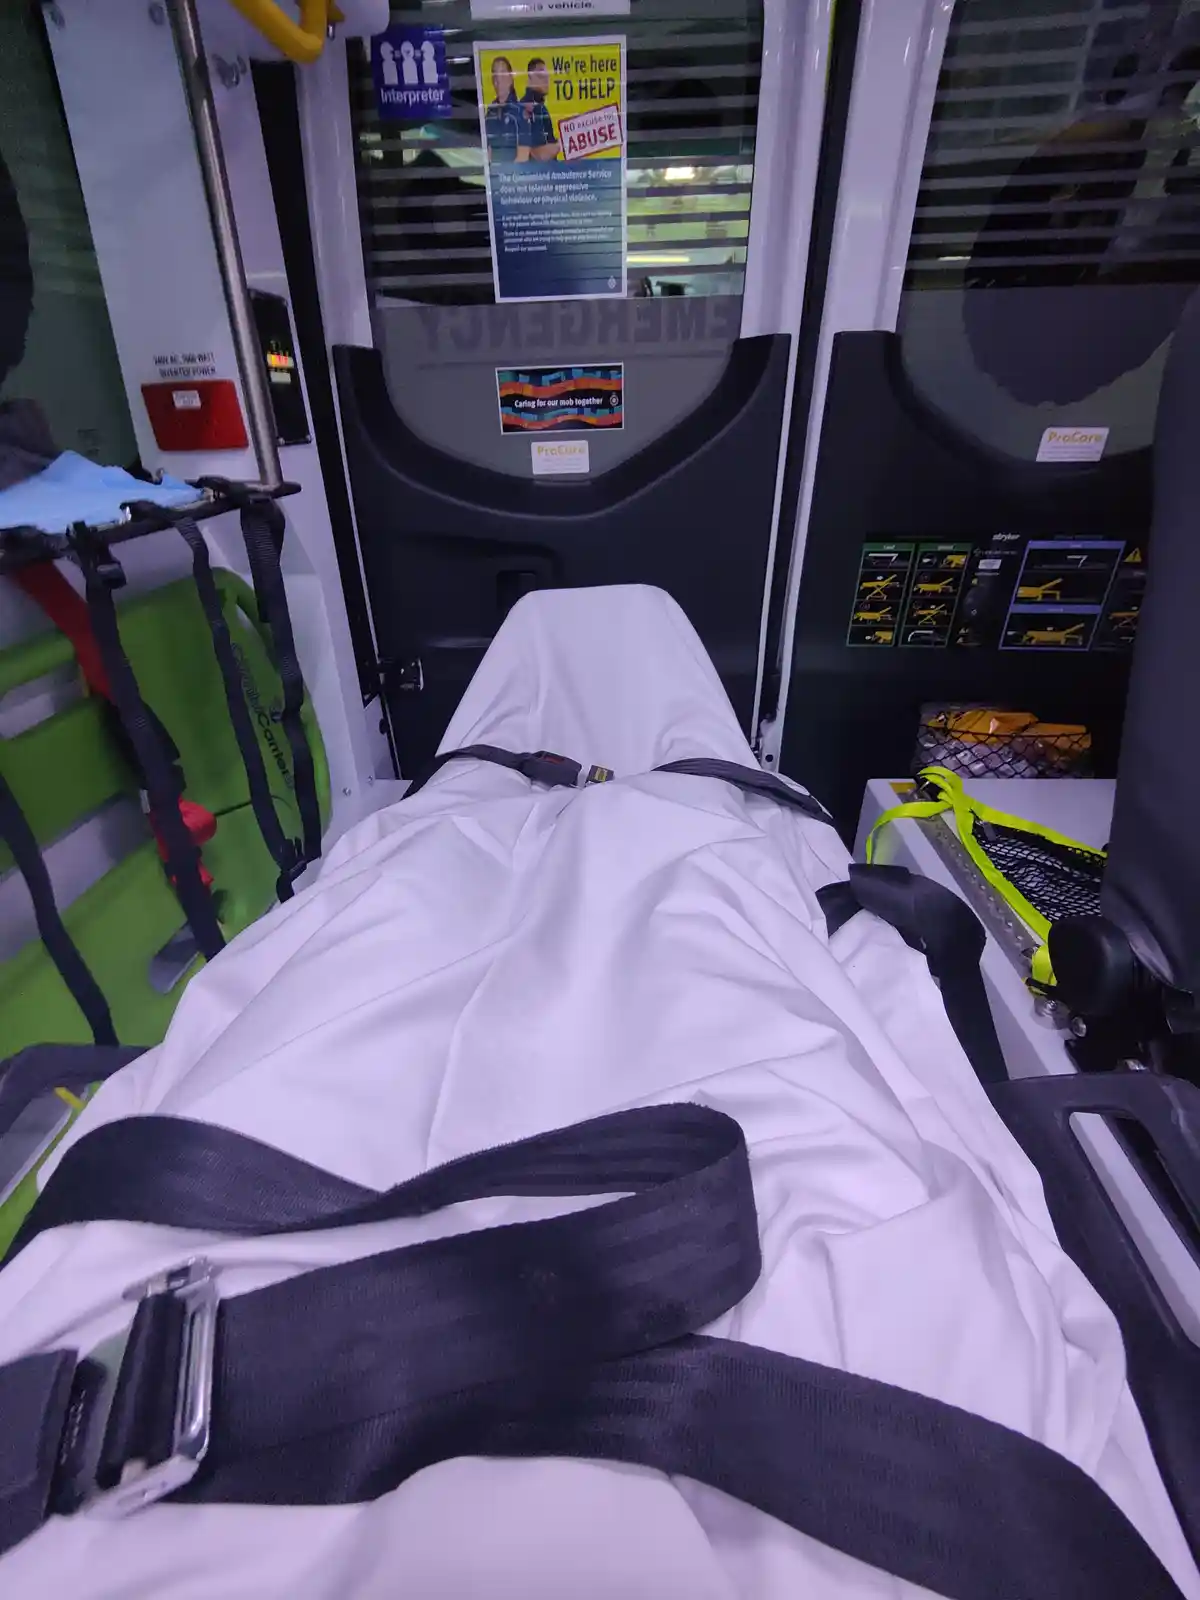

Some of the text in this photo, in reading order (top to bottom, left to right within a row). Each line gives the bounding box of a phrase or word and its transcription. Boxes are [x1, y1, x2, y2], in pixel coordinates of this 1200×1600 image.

[552, 55, 617, 74] We're here
[380, 88, 445, 108] Interpreter
[554, 77, 615, 101] TO HELP
[568, 122, 617, 154] ABUSE
[514, 396, 603, 409] Caring for our mob together
[992, 532, 1021, 542] stryker
